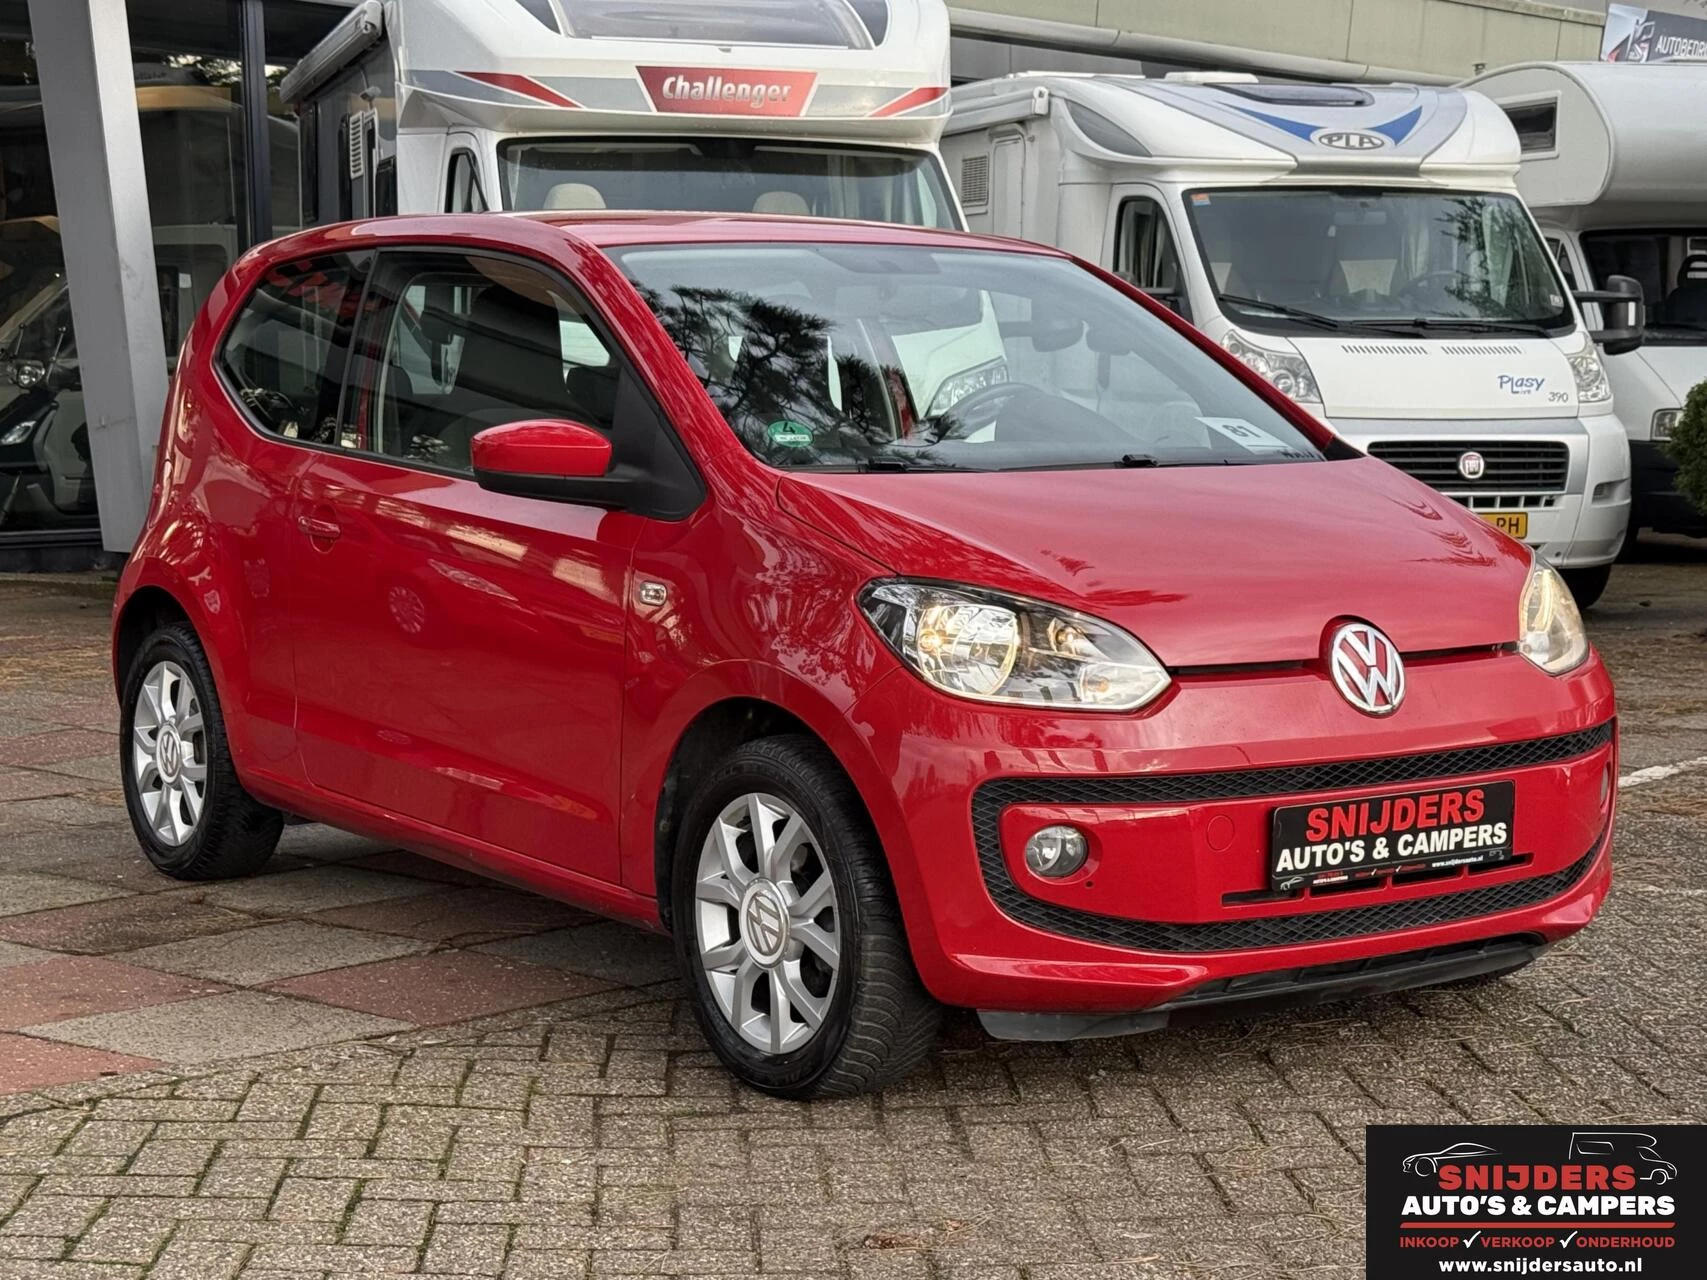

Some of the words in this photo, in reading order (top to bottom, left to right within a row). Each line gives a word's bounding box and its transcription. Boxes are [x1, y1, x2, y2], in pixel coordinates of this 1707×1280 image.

[662, 74, 792, 109] Challenger
[1324, 133, 1378, 148] PLA
[1548, 391, 1569, 403] 390
[783, 421, 796, 435] 4
[1222, 424, 1262, 438] 81
[1496, 517, 1520, 534] PH
[1306, 789, 1485, 842] SNIJDERS
[1276, 839, 1365, 873] AUTO'S
[1372, 836, 1390, 860] &
[1397, 822, 1508, 857] CAMPERS
